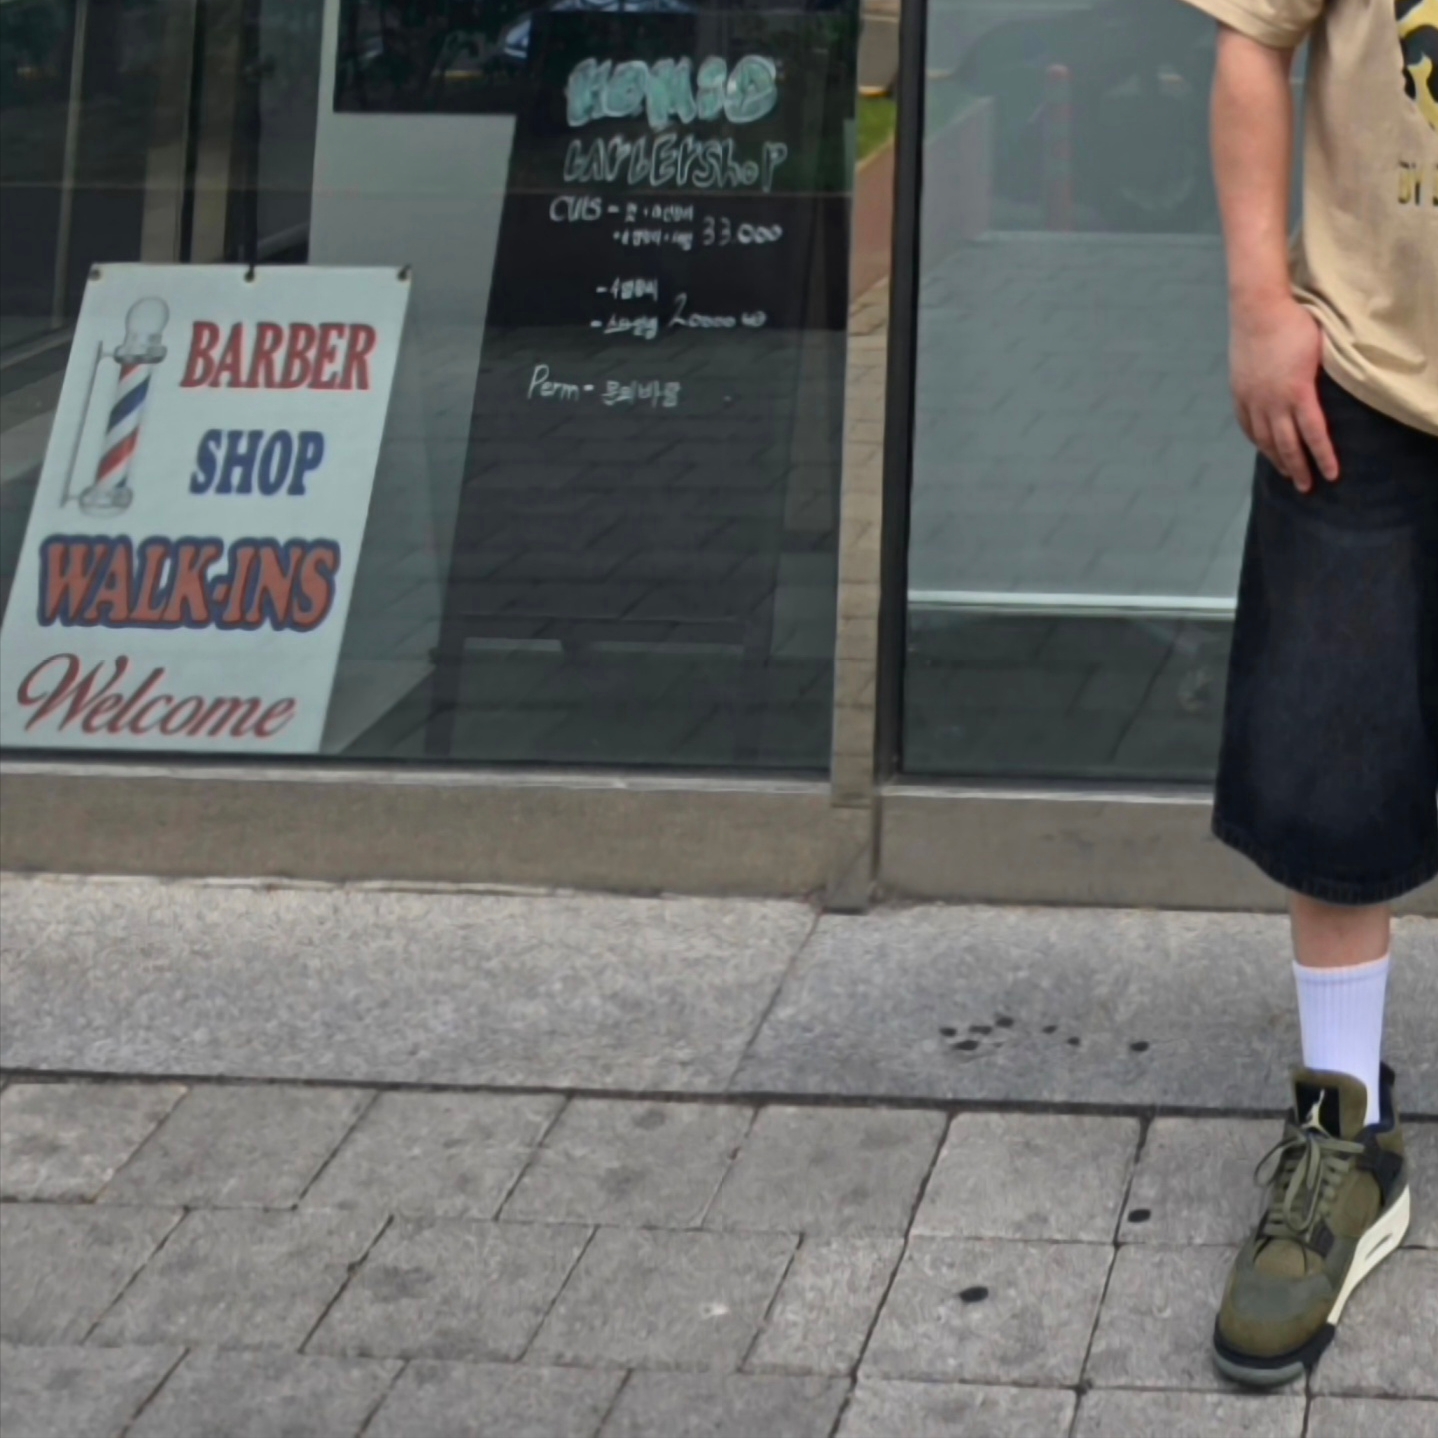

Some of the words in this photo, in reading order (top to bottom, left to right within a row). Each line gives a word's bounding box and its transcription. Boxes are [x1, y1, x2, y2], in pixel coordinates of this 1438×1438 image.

[179, 320, 378, 391] BARBER
[189, 428, 325, 496] SHOP
[37, 533, 341, 632] WALK-INS
[17, 652, 297, 740] Welcome
